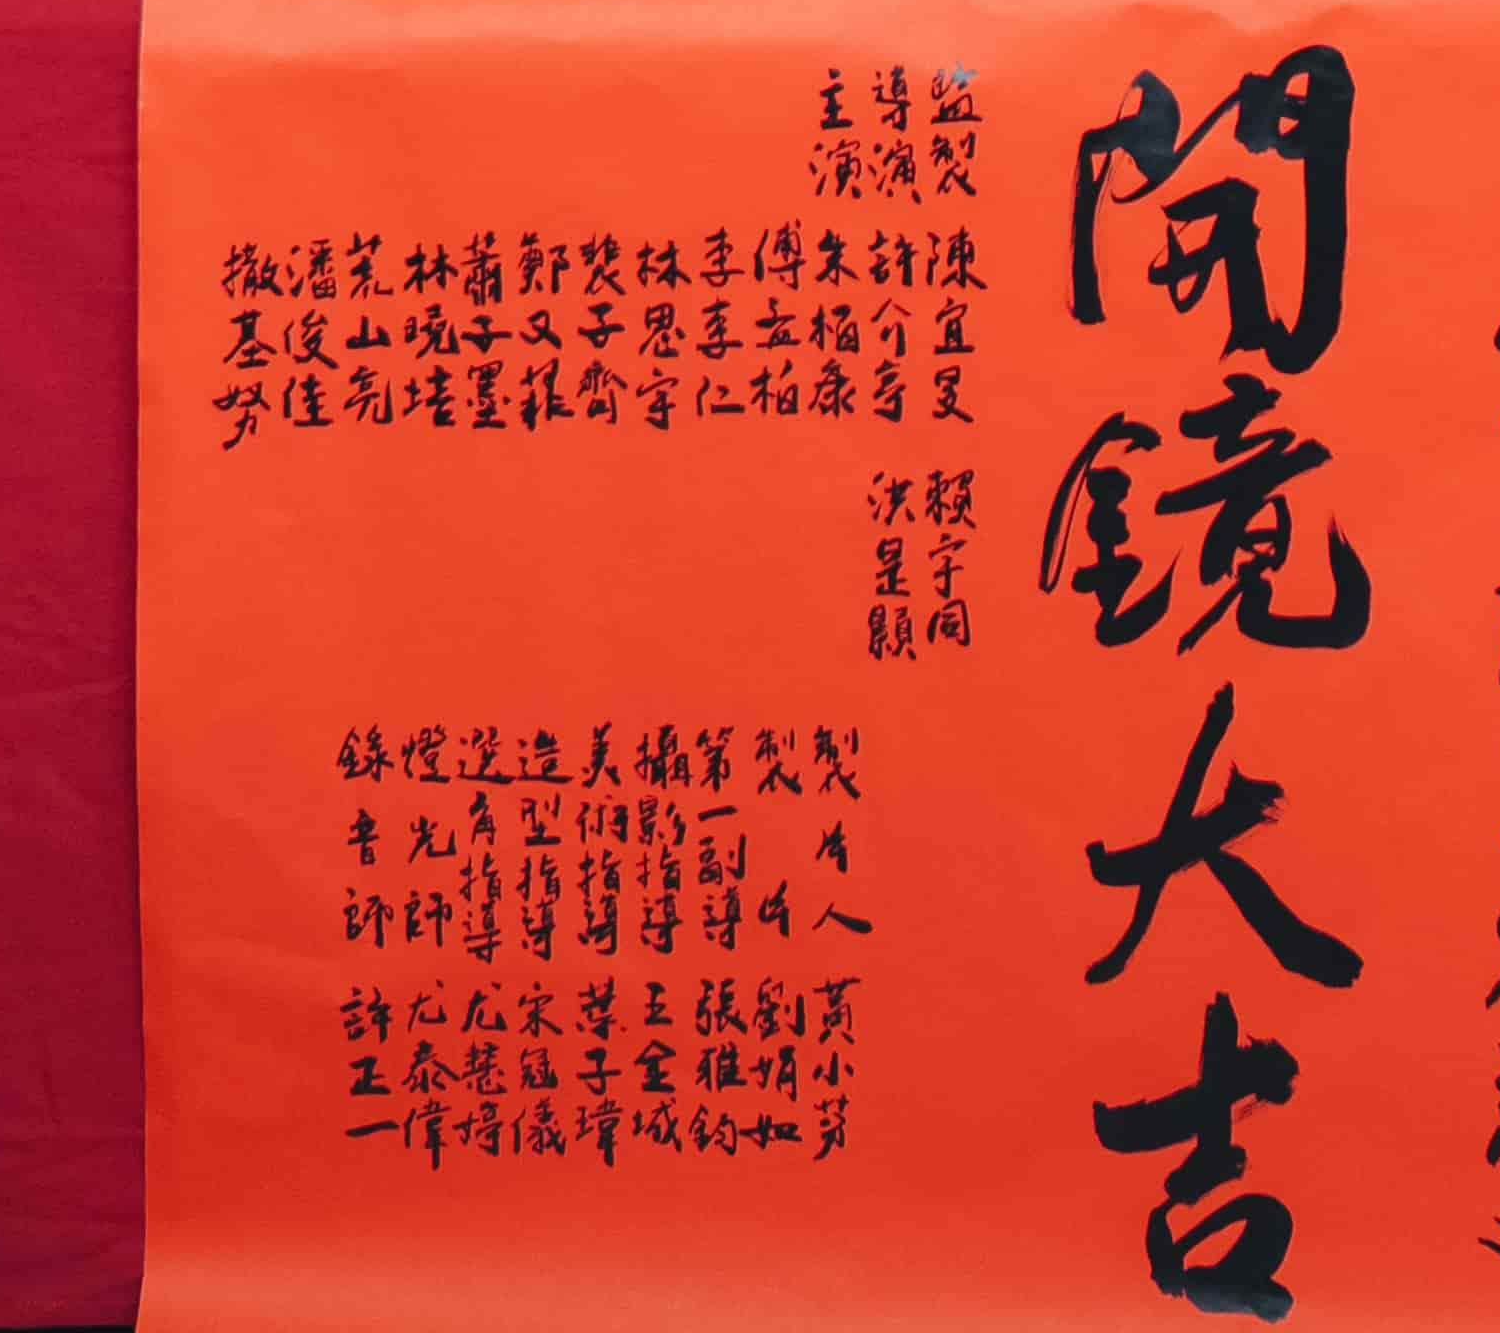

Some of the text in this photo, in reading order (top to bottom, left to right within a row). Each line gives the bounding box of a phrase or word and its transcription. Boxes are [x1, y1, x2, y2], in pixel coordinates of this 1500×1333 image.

[809, 67, 864, 200] 主演
[867, 64, 922, 205] 導演
[930, 62, 984, 198] 監製
[695, 225, 747, 416] 李李仁
[748, 216, 808, 418] 傅孟柏
[1039, 44, 1373, 1325] 開鏡大吉
[335, 724, 397, 949] 錄音師
[401, 724, 459, 949] 燈光師
[456, 725, 517, 966] 選角指導
[516, 726, 576, 962] 造型指導
[575, 720, 629, 958] 美術指導
[633, 723, 696, 957] 攝影指導
[696, 725, 747, 952] 第一副導
